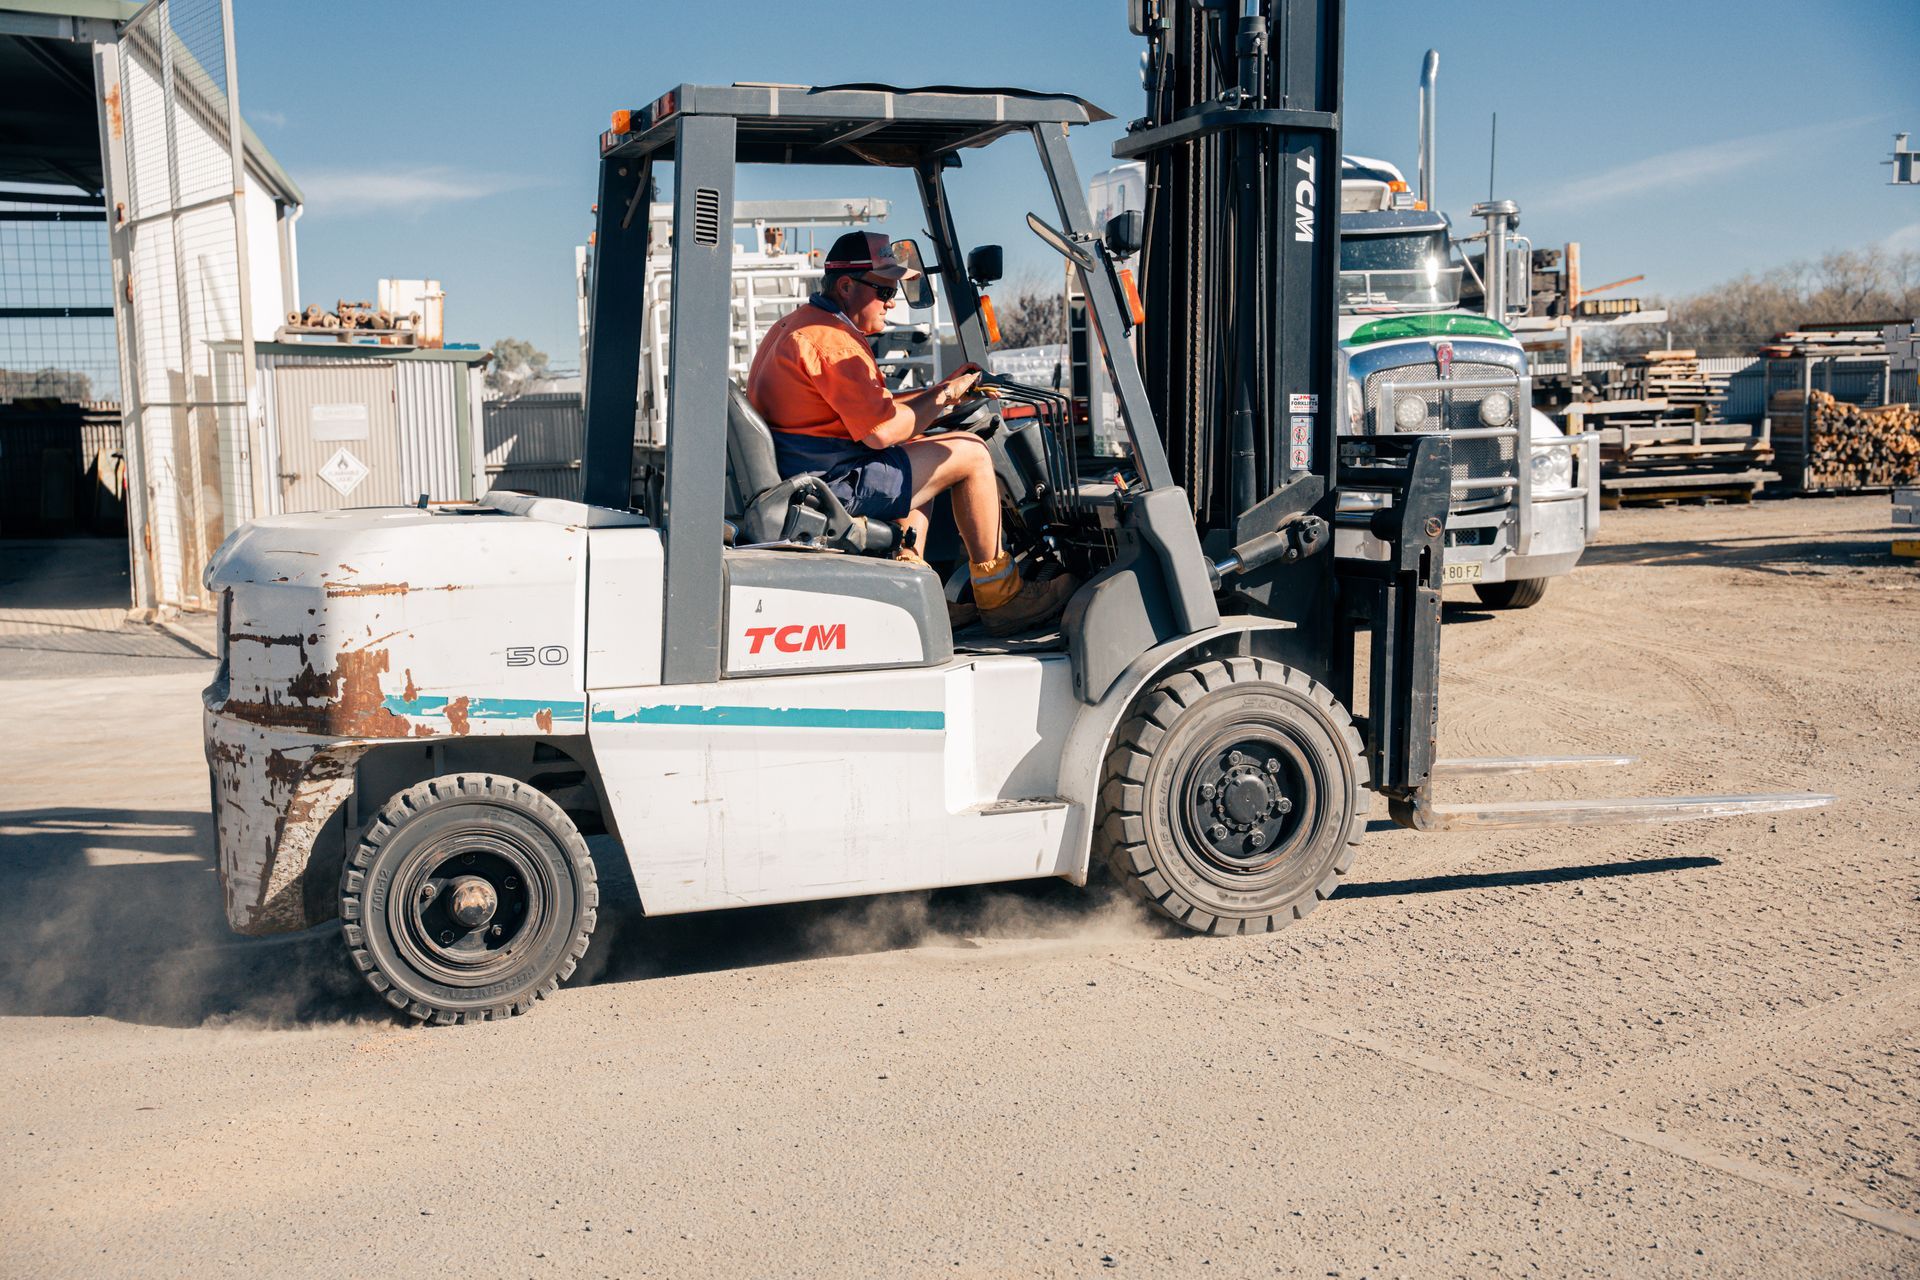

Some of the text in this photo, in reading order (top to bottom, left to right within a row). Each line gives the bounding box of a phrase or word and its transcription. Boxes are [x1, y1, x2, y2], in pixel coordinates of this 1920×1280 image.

[1295, 155, 1316, 242] TCM
[1449, 566, 1463, 578] 80
[1466, 565, 1480, 577] FZ
[744, 624, 846, 654] TCM
[506, 645, 569, 667] 50
